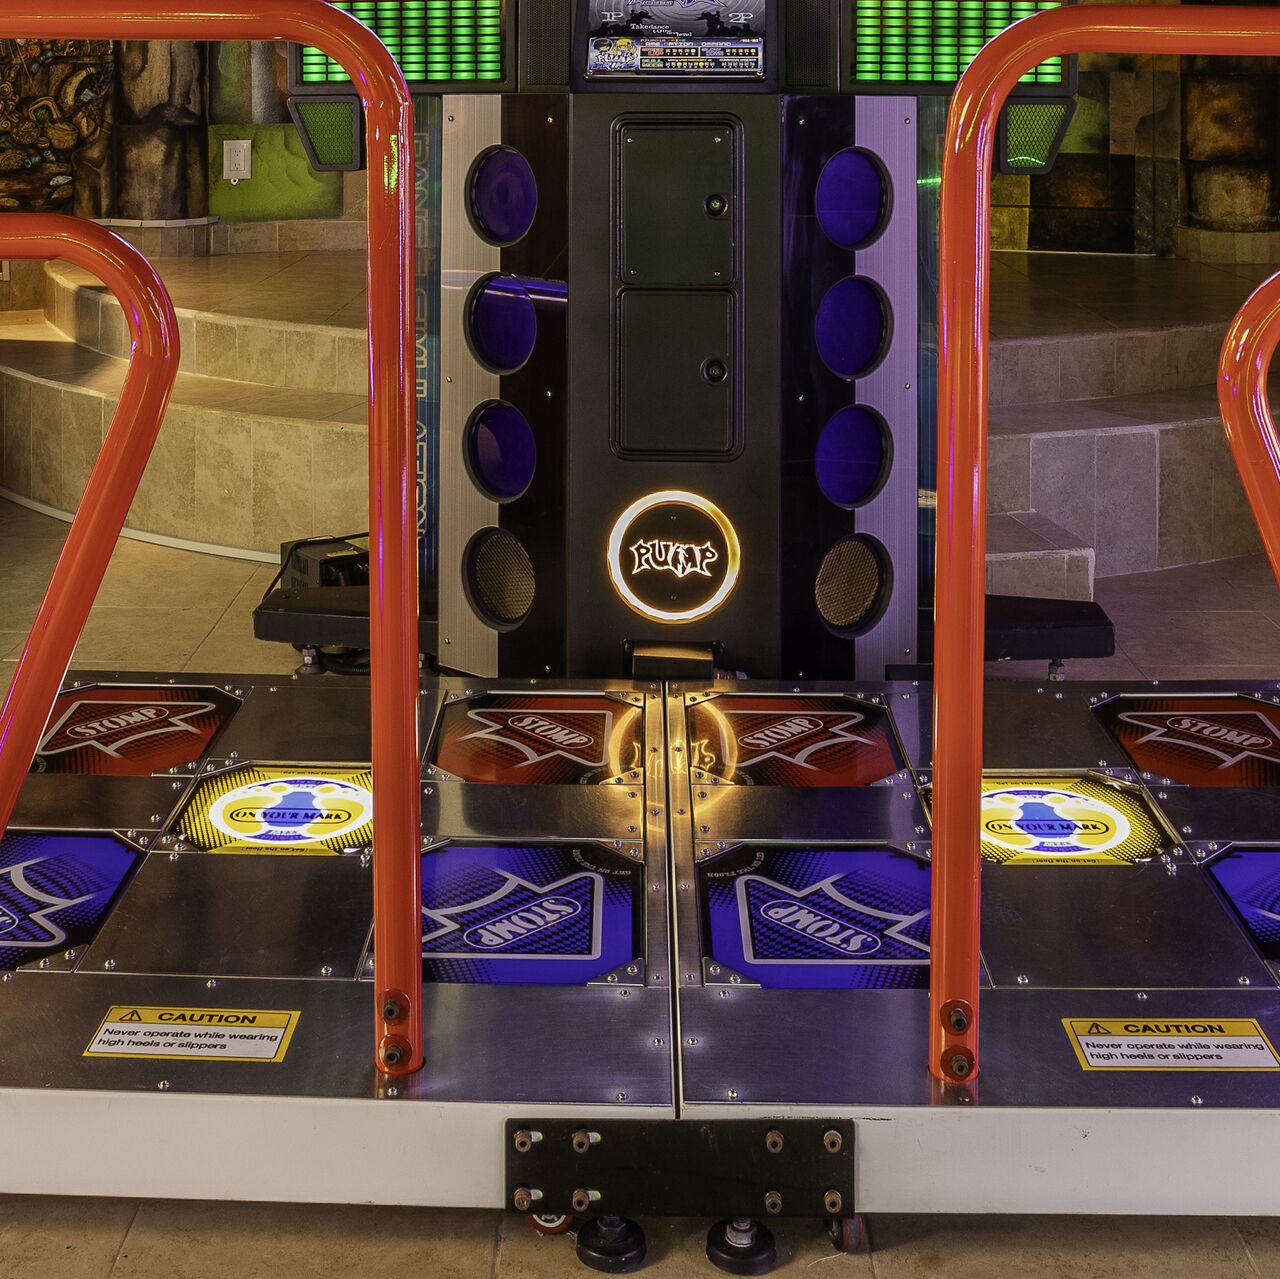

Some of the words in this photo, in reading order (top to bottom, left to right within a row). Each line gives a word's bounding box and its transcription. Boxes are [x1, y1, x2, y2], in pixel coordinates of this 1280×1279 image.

[728, 12, 754, 23] 2P
[629, 539, 718, 577] PUMP
[74, 708, 158, 737] STOMP
[515, 716, 589, 745] STOMP
[744, 718, 816, 747] STOMP
[1174, 719, 1266, 746] STOMP
[262, 811, 300, 819] YOUR
[303, 812, 343, 820] MARK
[990, 823, 1014, 831] ON
[1018, 823, 1057, 831] YOUR
[1058, 823, 1101, 831] MARK
[476, 899, 574, 947] STOMP
[767, 904, 872, 951] STOMP
[157, 1012, 257, 1024] CAUTION
[103, 1028, 141, 1036] Never
[143, 1031, 191, 1040] operate
[194, 1031, 226, 1039] while
[229, 1033, 279, 1042] wearing
[1123, 1024, 1225, 1033] CAUTION
[97, 1039, 125, 1047] high
[177, 1041, 227, 1050] slippers
[1126, 1042, 1175, 1051] operate
[1213, 1043, 1264, 1051] wearing
[1089, 1052, 1118, 1061] high
[1120, 1052, 1155, 1060] heels
[1172, 1053, 1223, 1061] slippers
